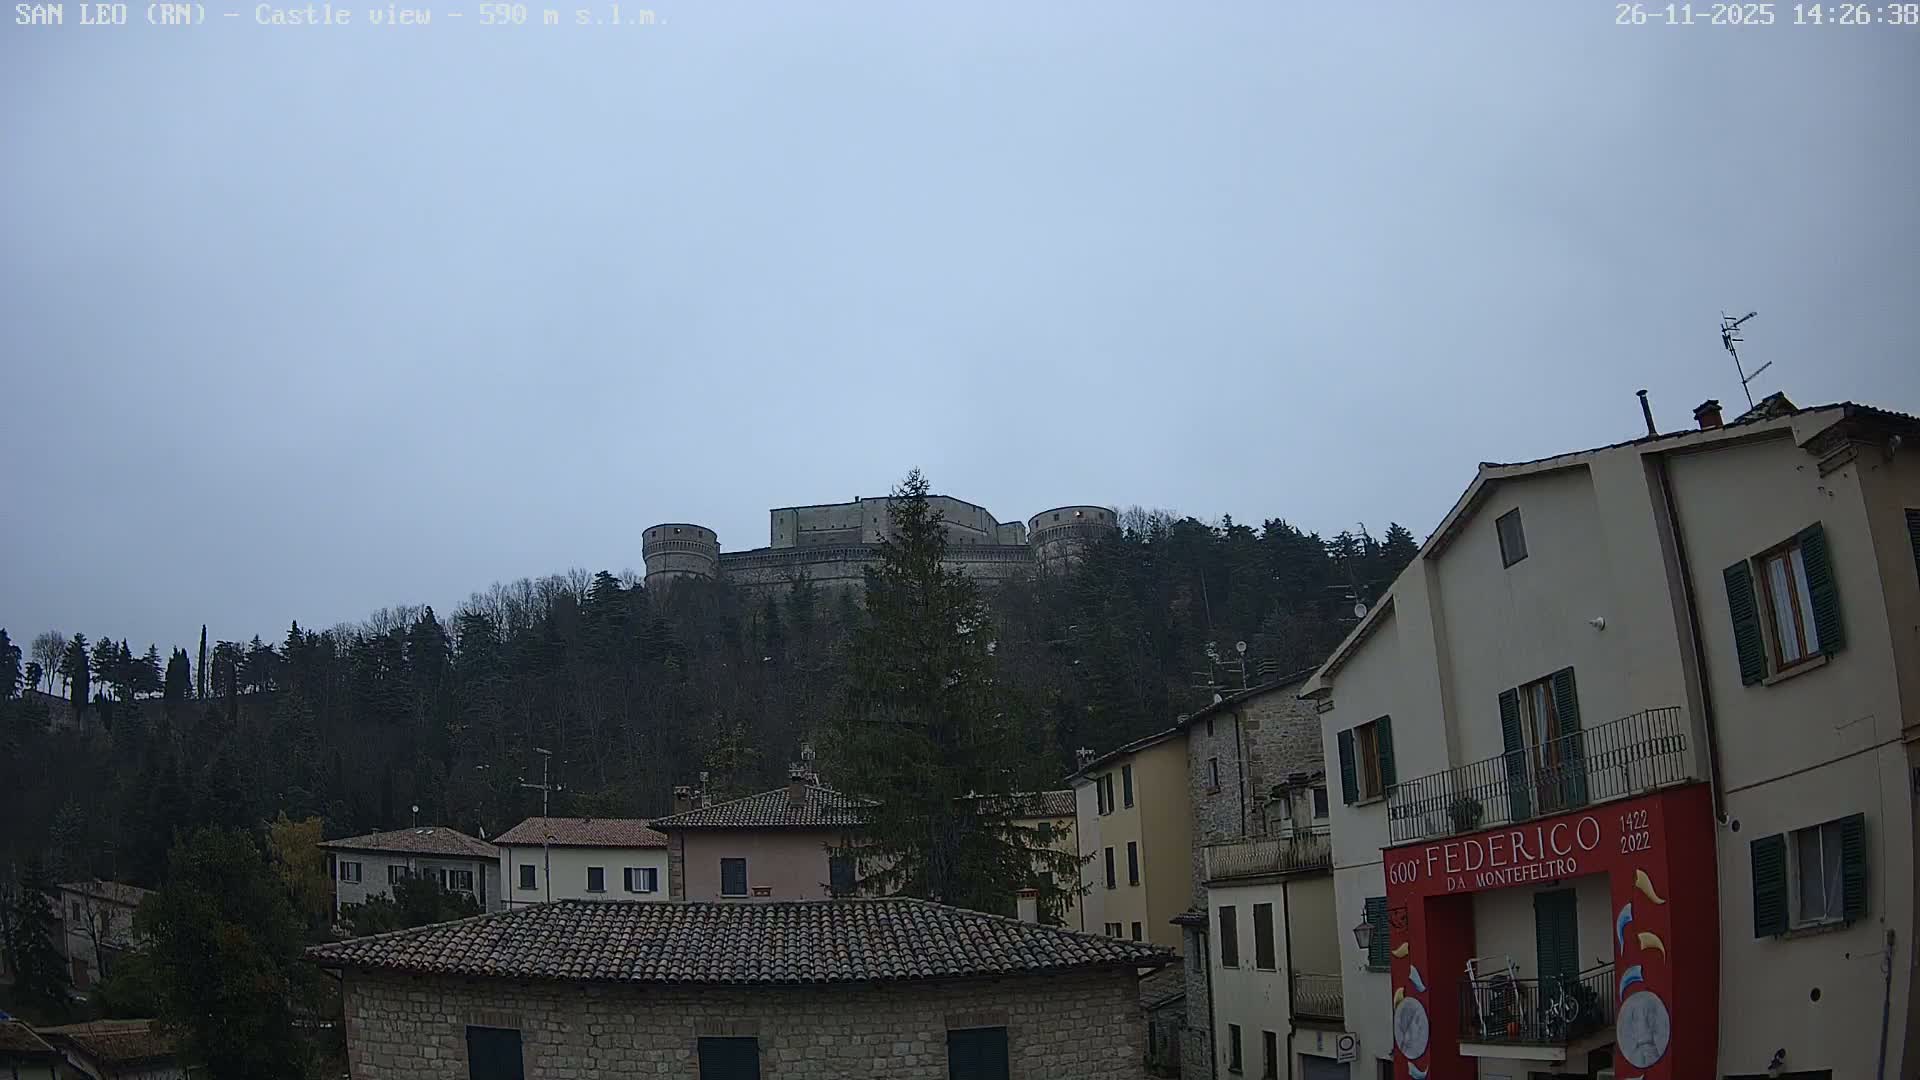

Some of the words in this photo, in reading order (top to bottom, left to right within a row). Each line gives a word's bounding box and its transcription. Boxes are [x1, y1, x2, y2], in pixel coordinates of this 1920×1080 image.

[1620, 809, 1649, 833] 1422
[1425, 816, 1600, 877] FEDERICO
[1620, 831, 1652, 854] 2022
[1447, 876, 1467, 892] DA
[1475, 857, 1577, 888] MONTEFELTRO
